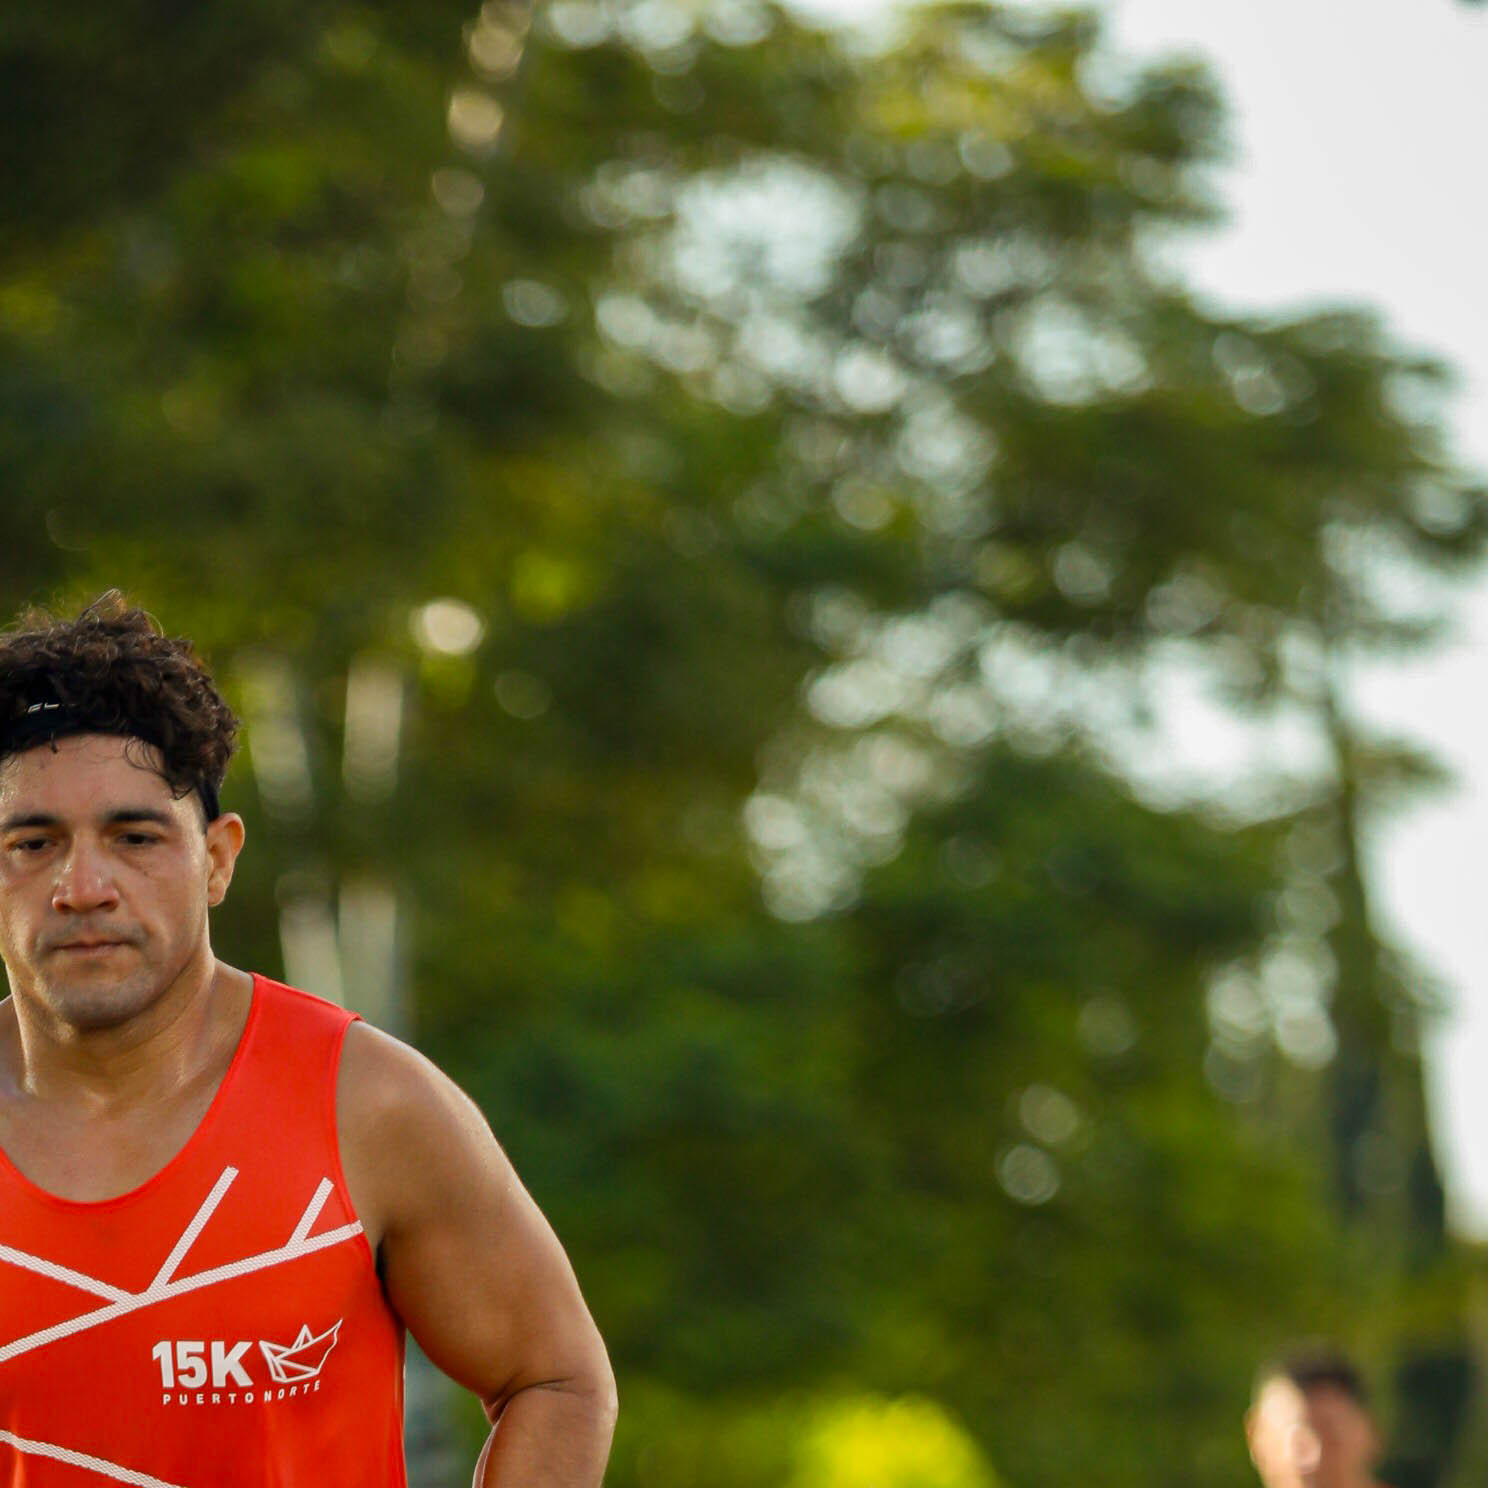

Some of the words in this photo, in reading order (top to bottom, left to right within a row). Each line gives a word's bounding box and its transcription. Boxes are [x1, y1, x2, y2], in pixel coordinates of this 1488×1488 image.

[152, 1340, 254, 1388] 15K
[163, 1392, 254, 1406] PUERTO
[264, 1379, 320, 1402] NORTE
